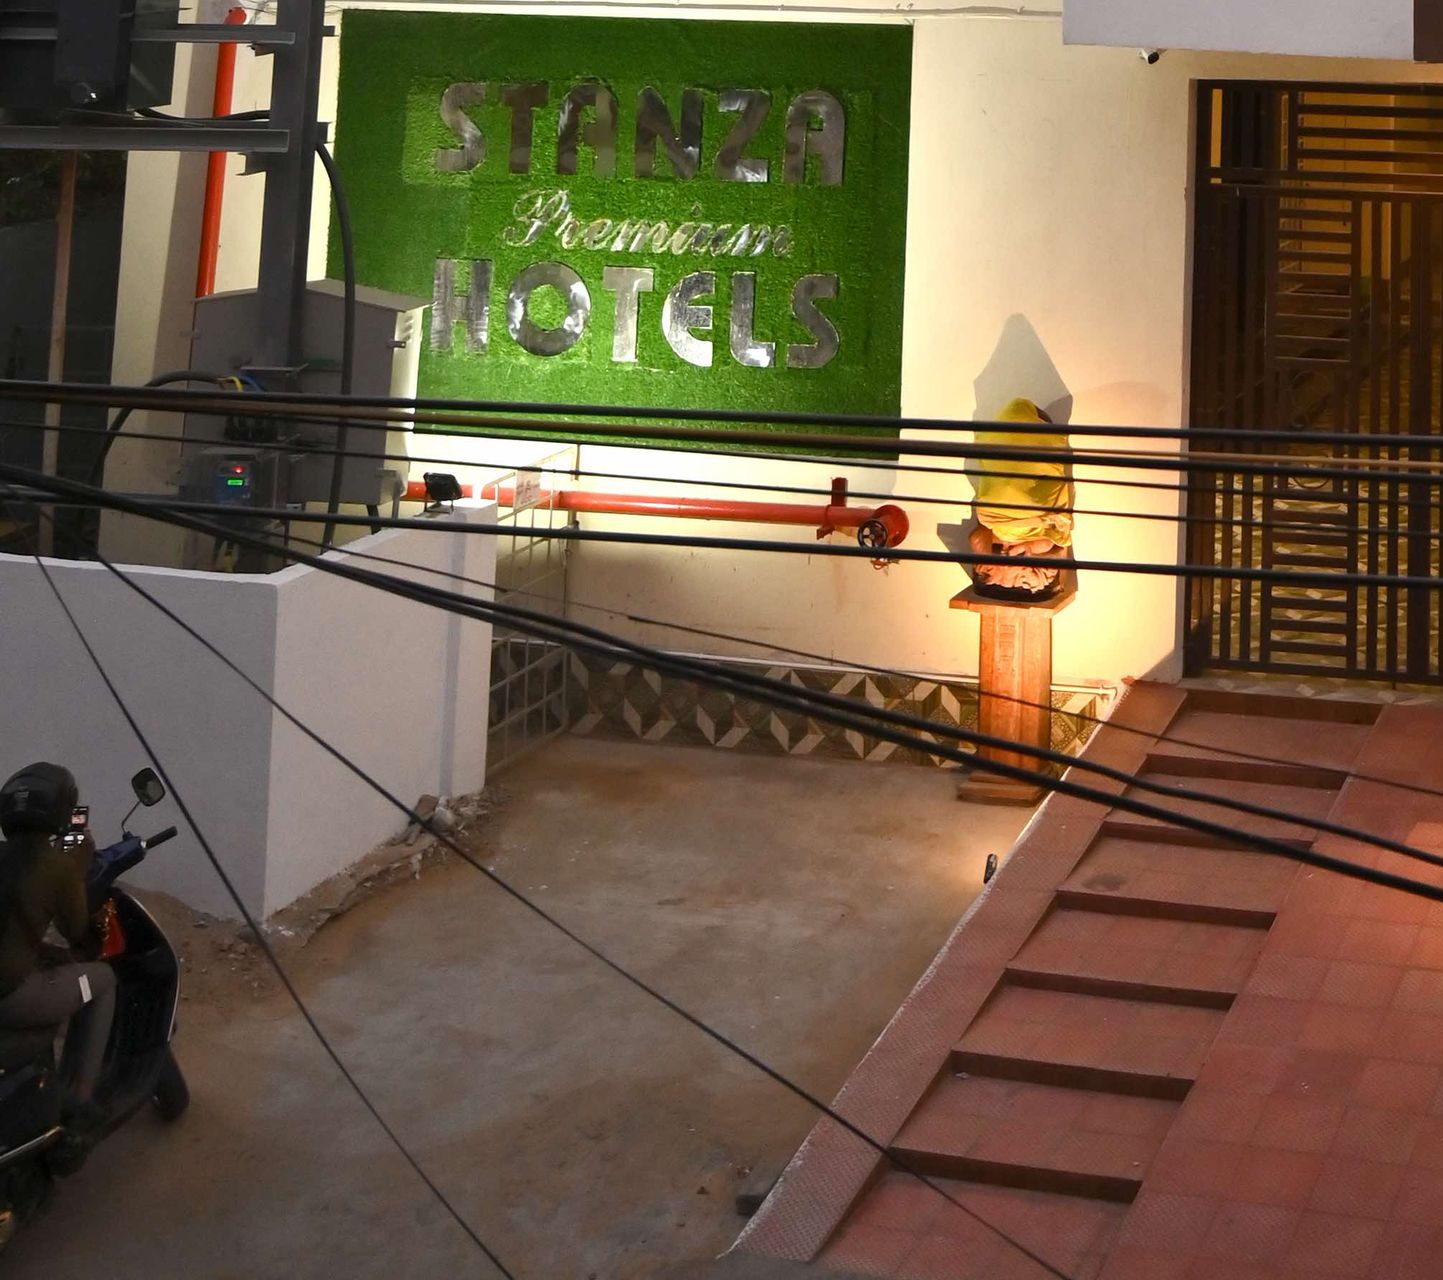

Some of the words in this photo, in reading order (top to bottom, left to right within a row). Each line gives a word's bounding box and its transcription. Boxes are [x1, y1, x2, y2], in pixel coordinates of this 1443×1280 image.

[436, 80, 846, 187] STANZA
[505, 189, 796, 257] Premium
[430, 257, 841, 369] HOTELS
